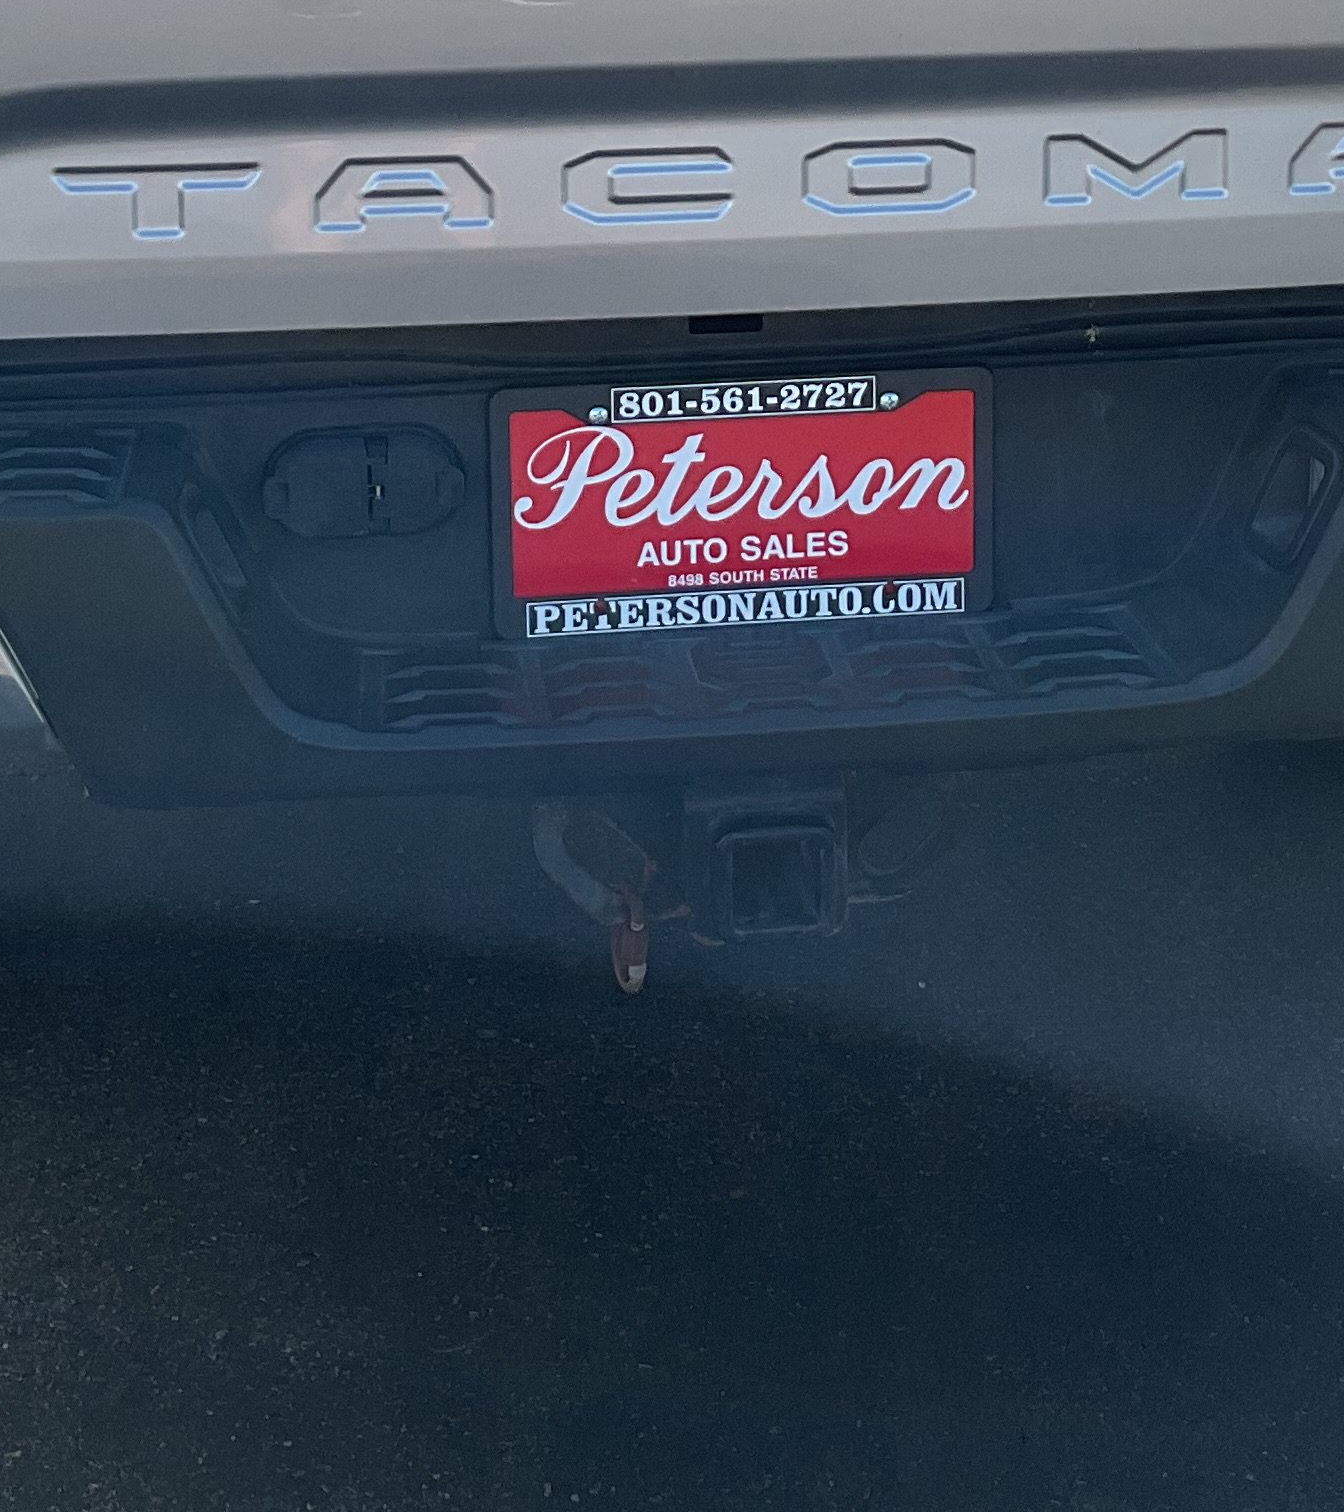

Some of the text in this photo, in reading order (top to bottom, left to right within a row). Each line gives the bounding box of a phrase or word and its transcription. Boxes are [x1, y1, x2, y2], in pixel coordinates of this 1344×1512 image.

[618, 381, 868, 419] 801-561-2727
[513, 425, 970, 530] Peterson
[637, 530, 850, 568] AUTO SALES
[667, 565, 819, 588] 8498 SOUTH STATE
[533, 581, 958, 635] PETERSONAUTO.COM
